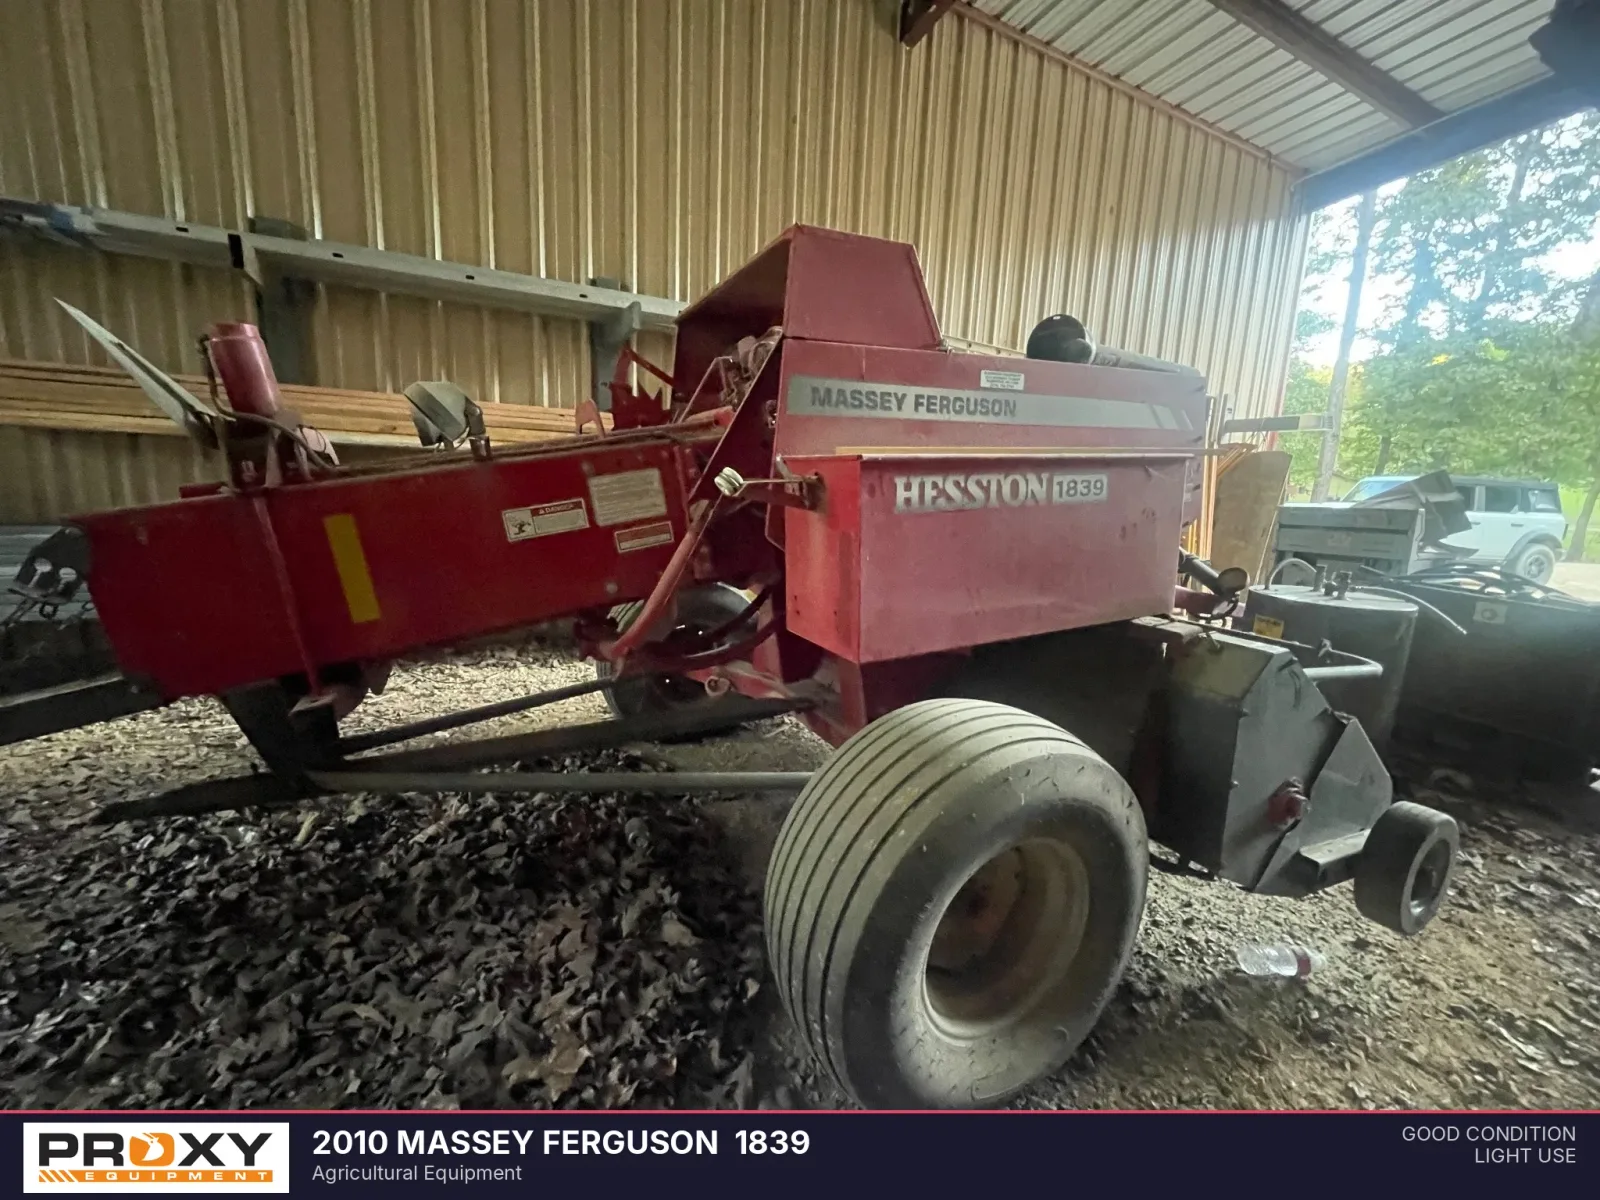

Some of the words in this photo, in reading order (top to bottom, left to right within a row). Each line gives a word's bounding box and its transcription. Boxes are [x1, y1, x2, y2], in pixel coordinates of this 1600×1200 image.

[811, 386, 907, 413] MASSEY
[913, 394, 1018, 418] FERGUSON
[894, 473, 1050, 511] HESSTON
[1055, 477, 1105, 501] 1839
